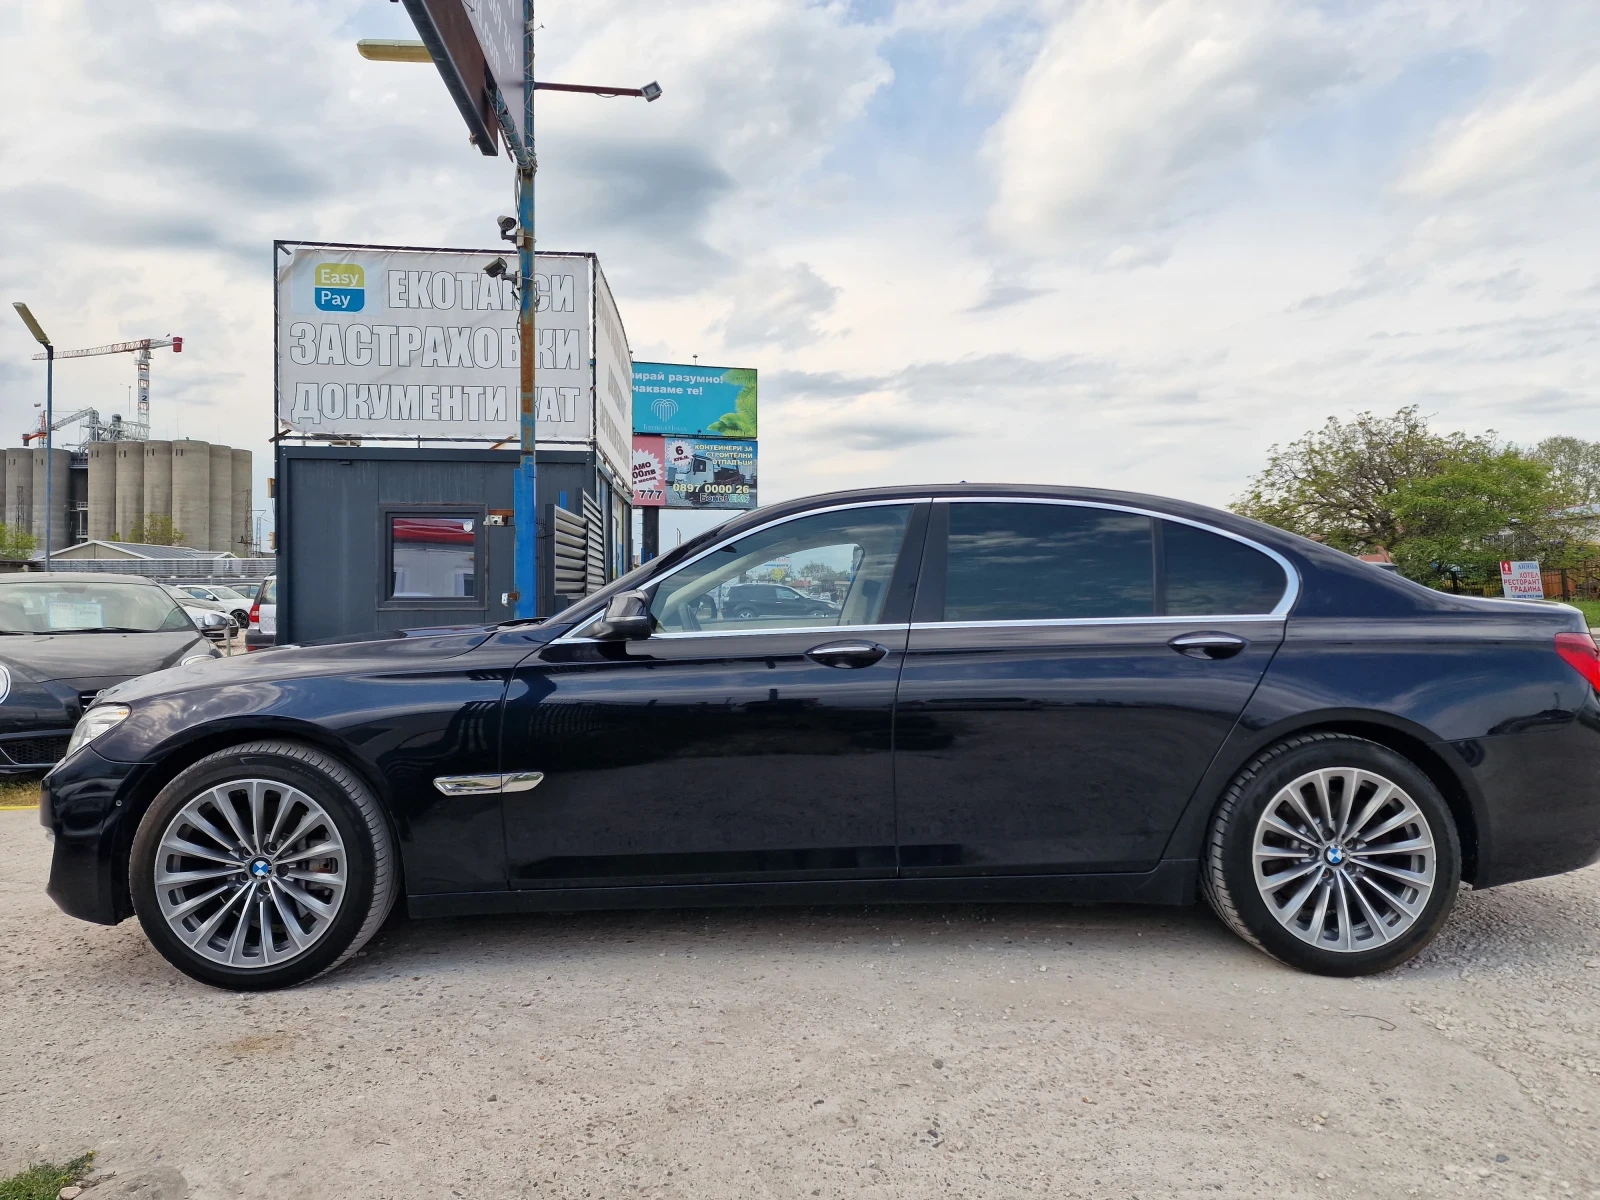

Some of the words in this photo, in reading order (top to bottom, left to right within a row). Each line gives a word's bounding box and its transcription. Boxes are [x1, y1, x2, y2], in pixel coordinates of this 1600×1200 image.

[321, 268, 359, 287] Easy
[321, 290, 351, 309] Pay
[289, 321, 581, 371] ЗАСТРАХОВКИ
[668, 374, 724, 384] разумно!
[686, 387, 703, 395] те!
[290, 382, 508, 425] ДОКУМЕНТИ
[675, 445, 684, 455] 6
[672, 483, 700, 493] 0897
[704, 484, 733, 493] 0000
[735, 485, 750, 494] 26
[639, 489, 663, 500] 777
